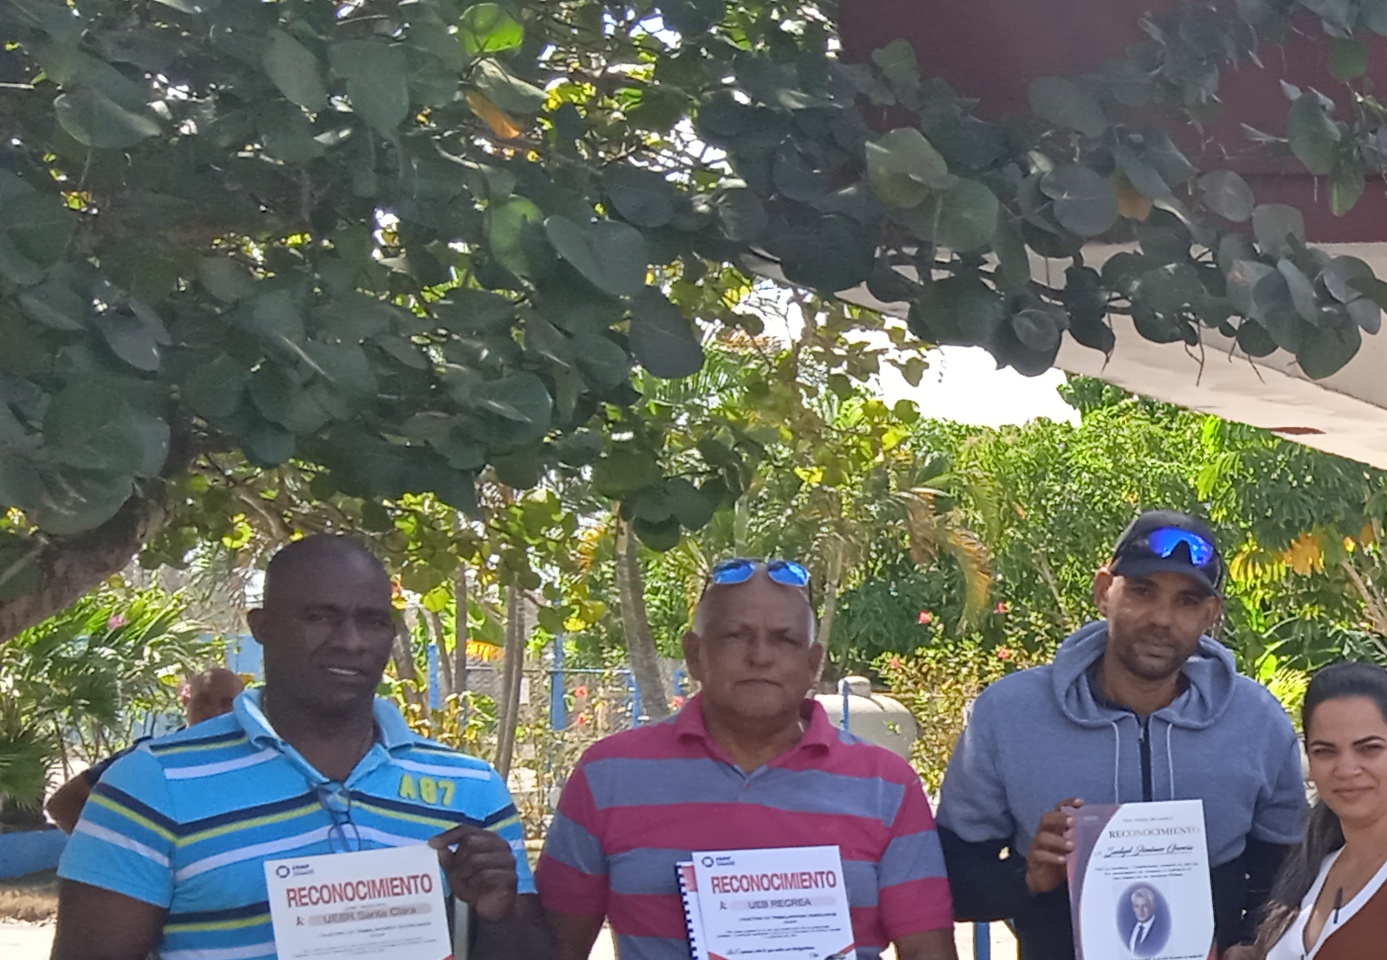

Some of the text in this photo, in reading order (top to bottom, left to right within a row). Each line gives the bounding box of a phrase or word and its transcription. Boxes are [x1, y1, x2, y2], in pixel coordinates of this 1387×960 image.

[1109, 827, 1200, 839] RECONOCIMIENTO
[286, 873, 433, 908] RECONOCIMIENTO
[711, 870, 837, 894] RECONOCIMIENTO
